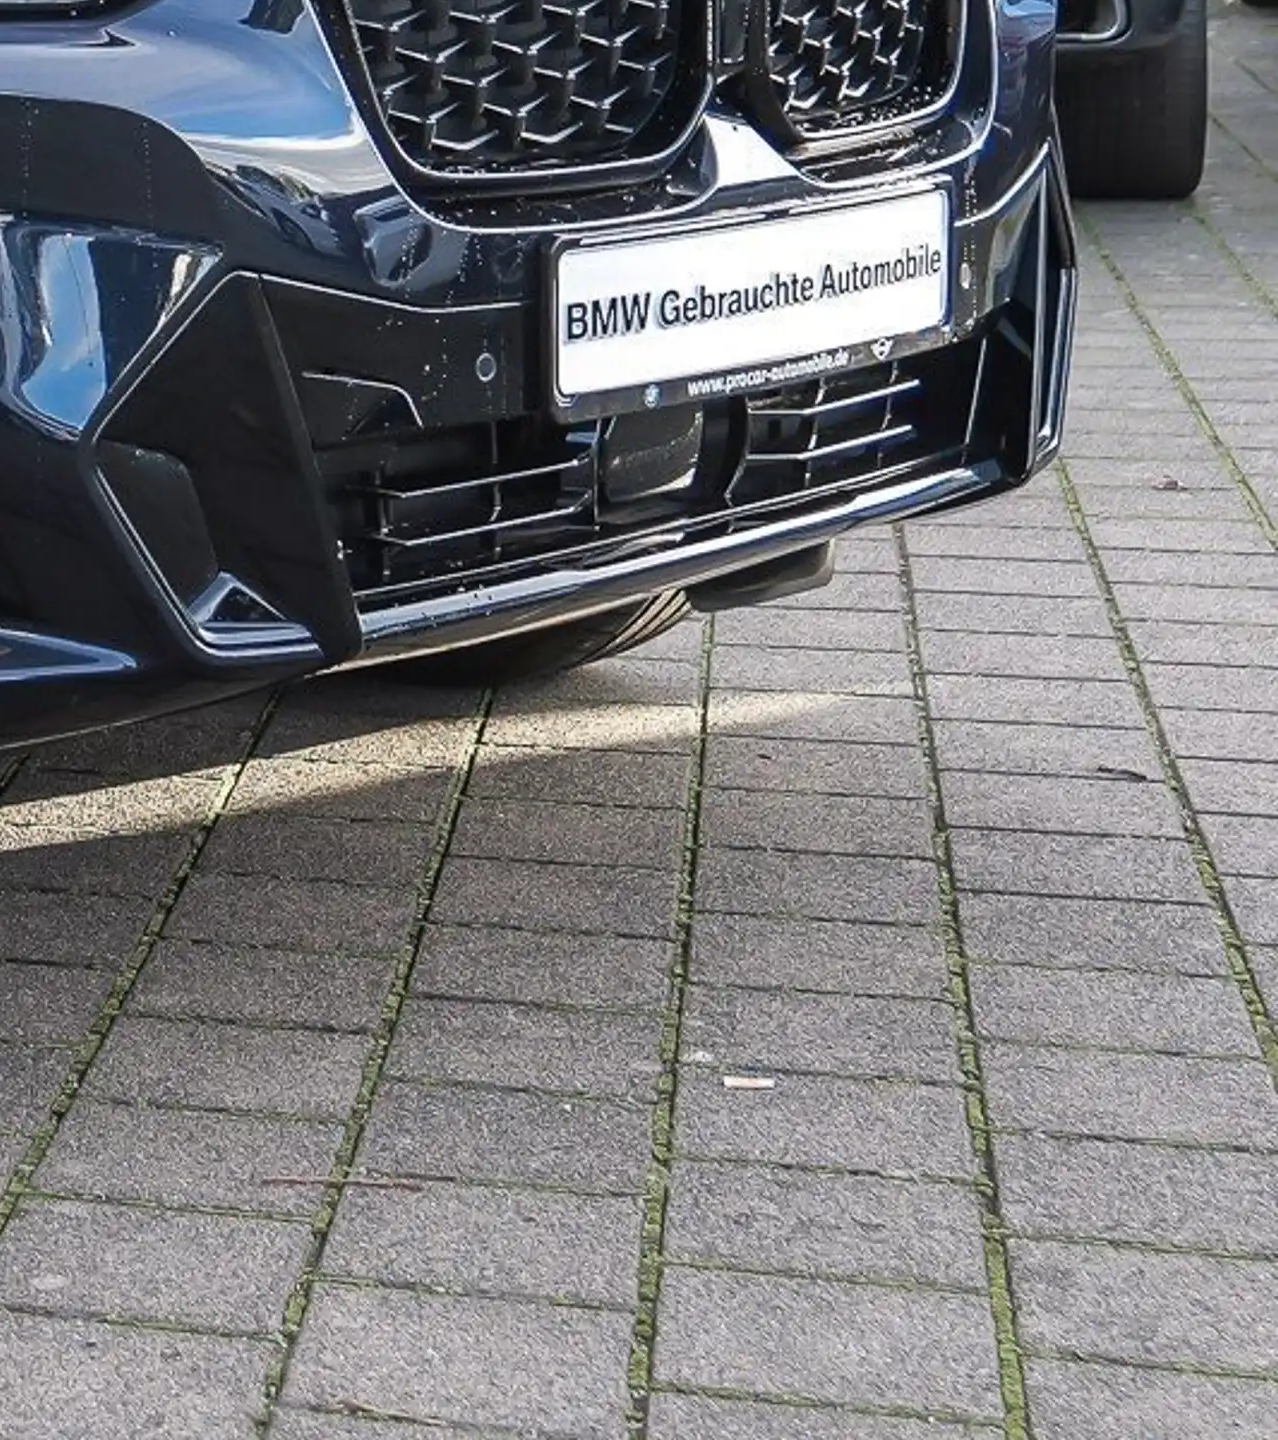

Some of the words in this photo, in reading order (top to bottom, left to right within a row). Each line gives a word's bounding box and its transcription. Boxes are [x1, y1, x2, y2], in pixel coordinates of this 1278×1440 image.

[566, 292, 651, 341] BMW
[659, 272, 815, 329] Gebrauchte
[820, 246, 942, 299] Automobile
